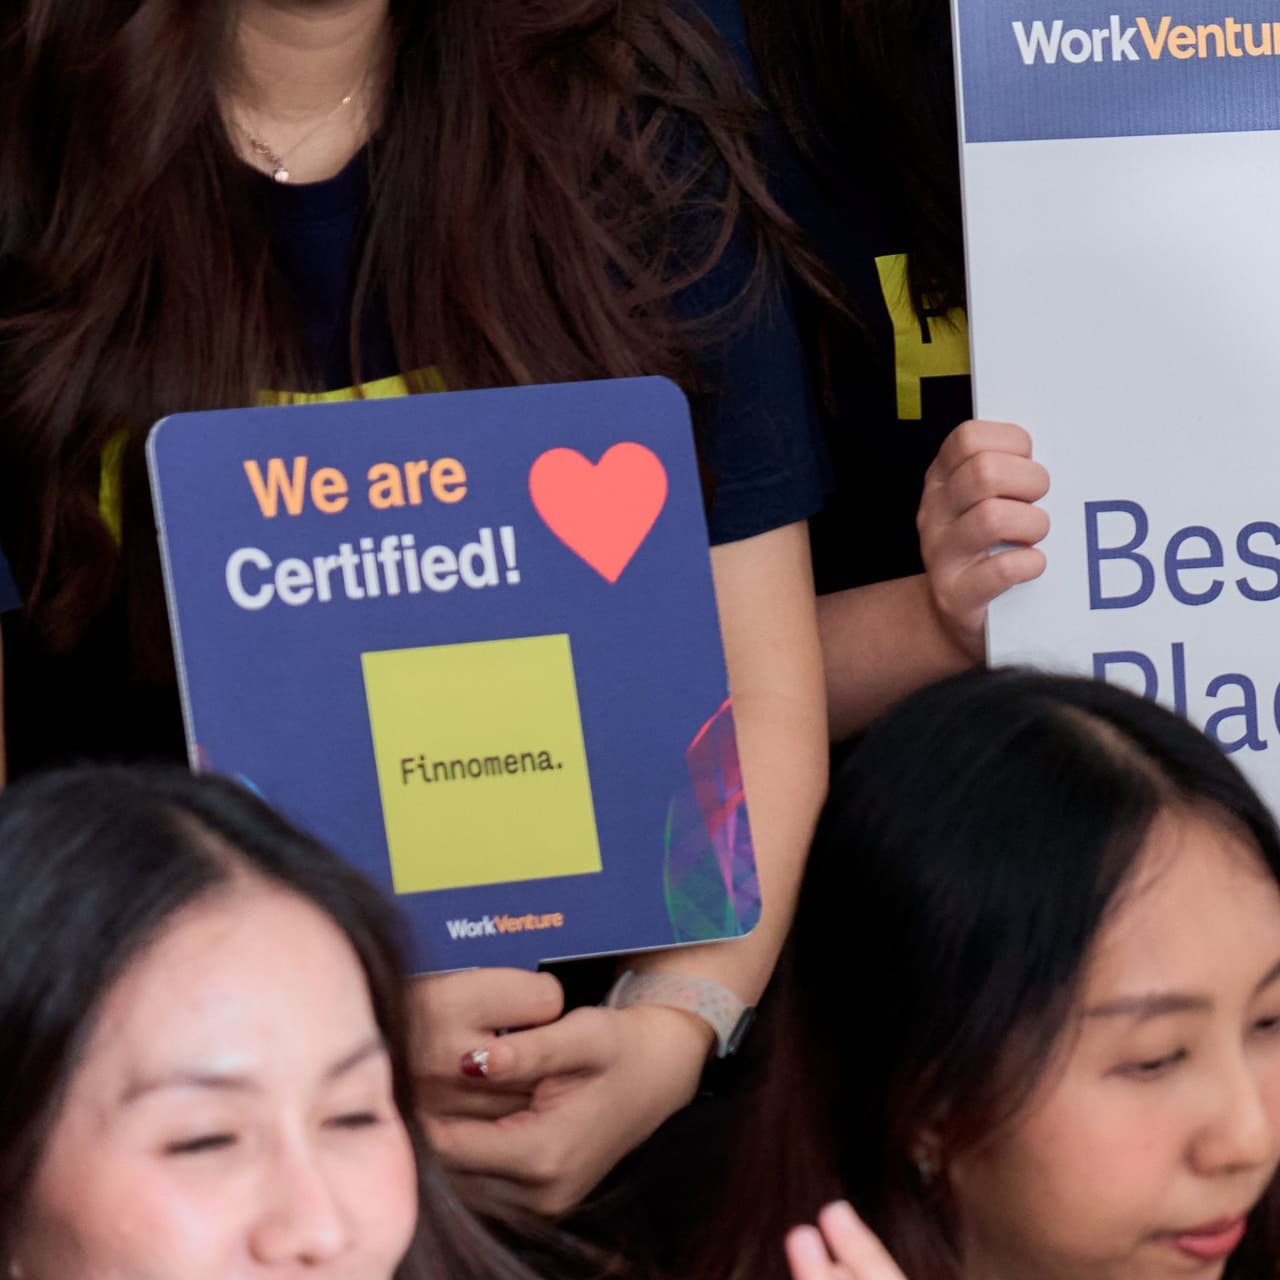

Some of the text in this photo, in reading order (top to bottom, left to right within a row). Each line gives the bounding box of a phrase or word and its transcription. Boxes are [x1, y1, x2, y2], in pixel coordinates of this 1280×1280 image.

[242, 455, 468, 519] We are
[224, 525, 521, 612] Certified!
[400, 749, 563, 787] Finnomena.
[445, 912, 565, 940] WorkVenture
